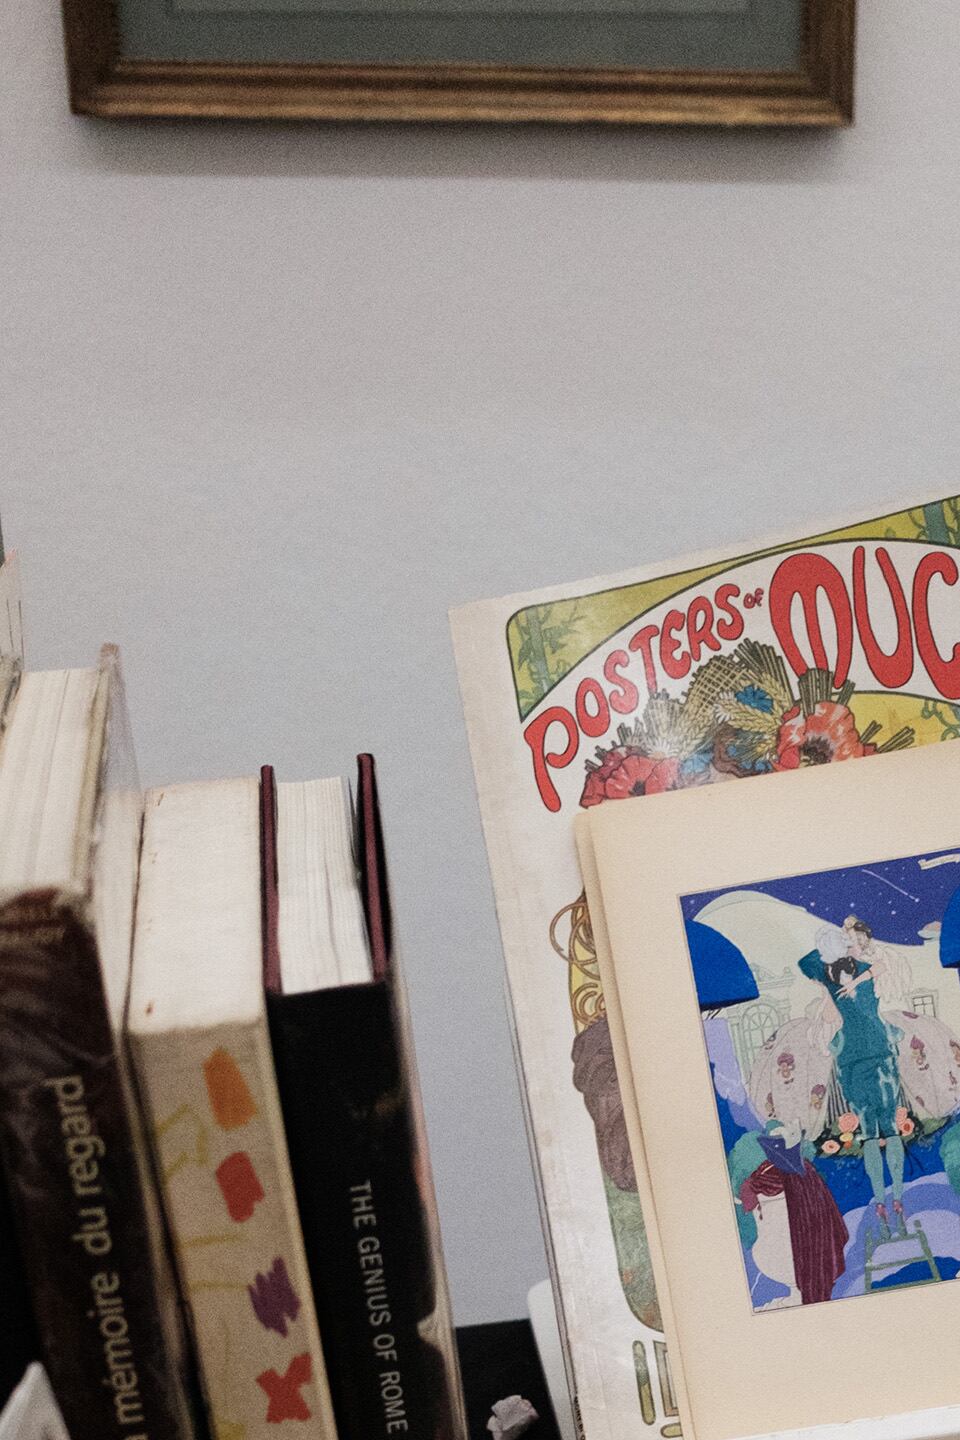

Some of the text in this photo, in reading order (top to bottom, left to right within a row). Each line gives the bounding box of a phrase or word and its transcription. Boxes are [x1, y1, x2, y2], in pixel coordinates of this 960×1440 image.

[523, 582, 742, 813] POSTERS
[43, 1075, 106, 1196] regard
[71, 1206, 113, 1256] du
[350, 1179, 377, 1230] THE
[357, 1236, 392, 1327] GENIUS
[86, 1271, 145, 1424] mémoire
[373, 1333, 398, 1362] OF
[379, 1371, 409, 1435] ROME
